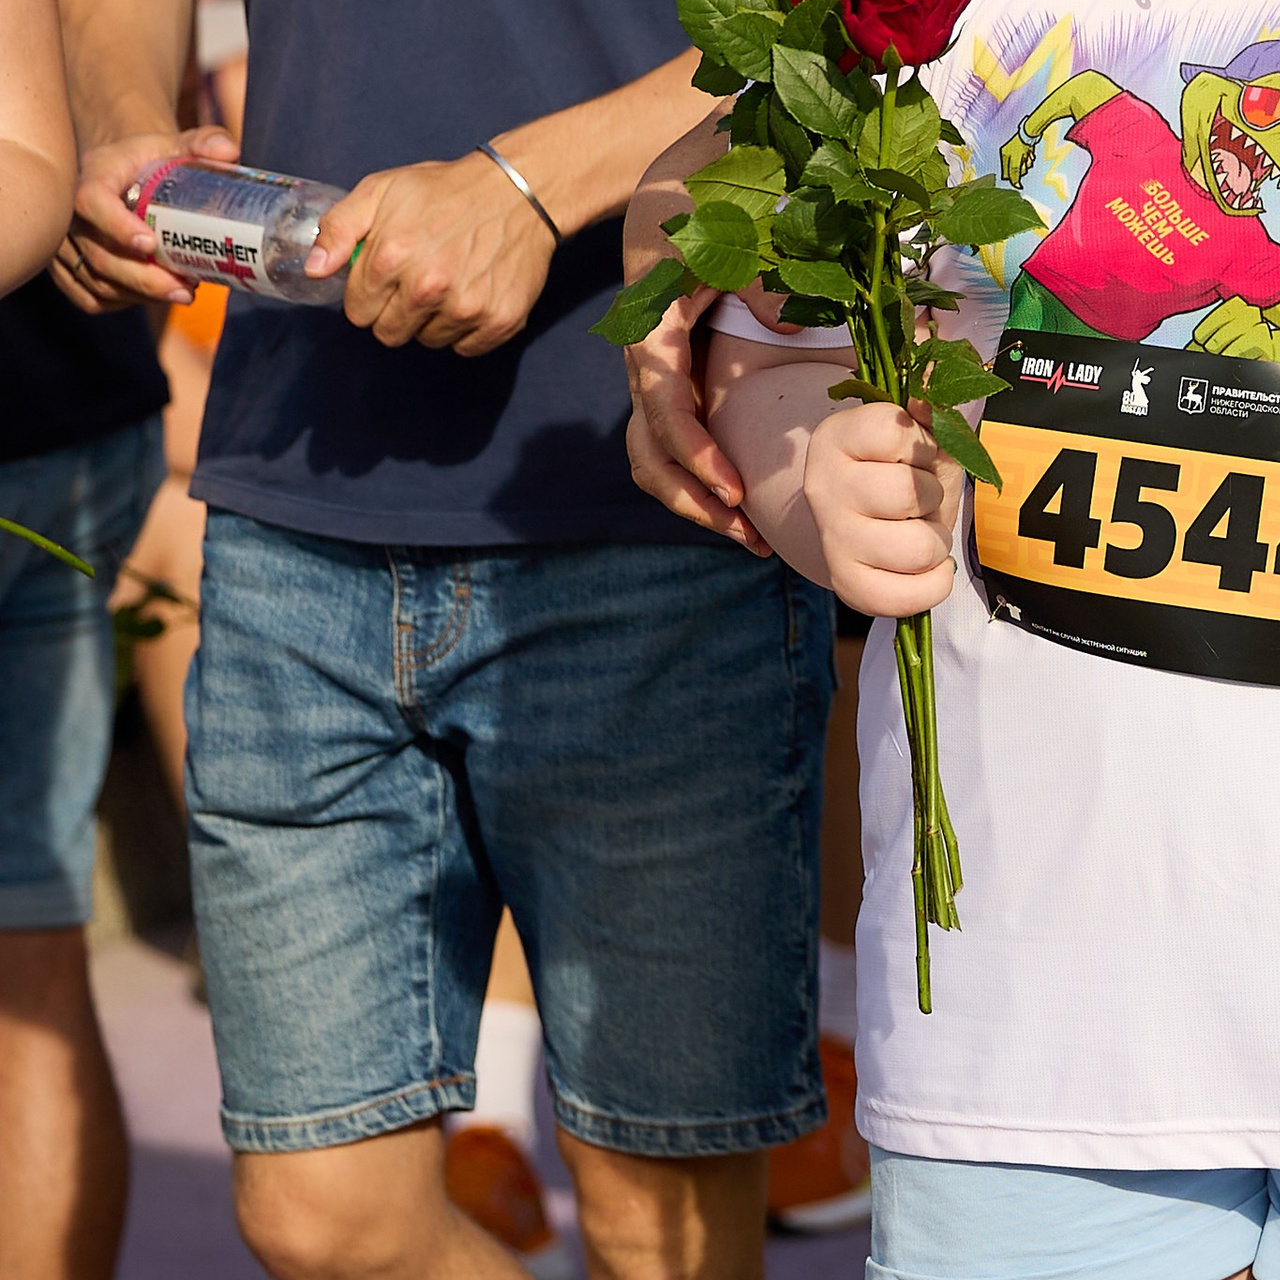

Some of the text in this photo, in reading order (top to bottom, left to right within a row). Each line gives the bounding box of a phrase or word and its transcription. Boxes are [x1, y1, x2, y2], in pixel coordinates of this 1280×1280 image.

[1140, 178, 1210, 246] БОЛЬШЕ
[1141, 201, 1174, 239] ЧЕМ
[162, 229, 258, 264] FAHRENHEIT
[1105, 197, 1175, 265] МОЖЕШЬ
[1021, 357, 1104, 384] IRON LADY
[1209, 405, 1249, 418] ОБЛАСТИ
